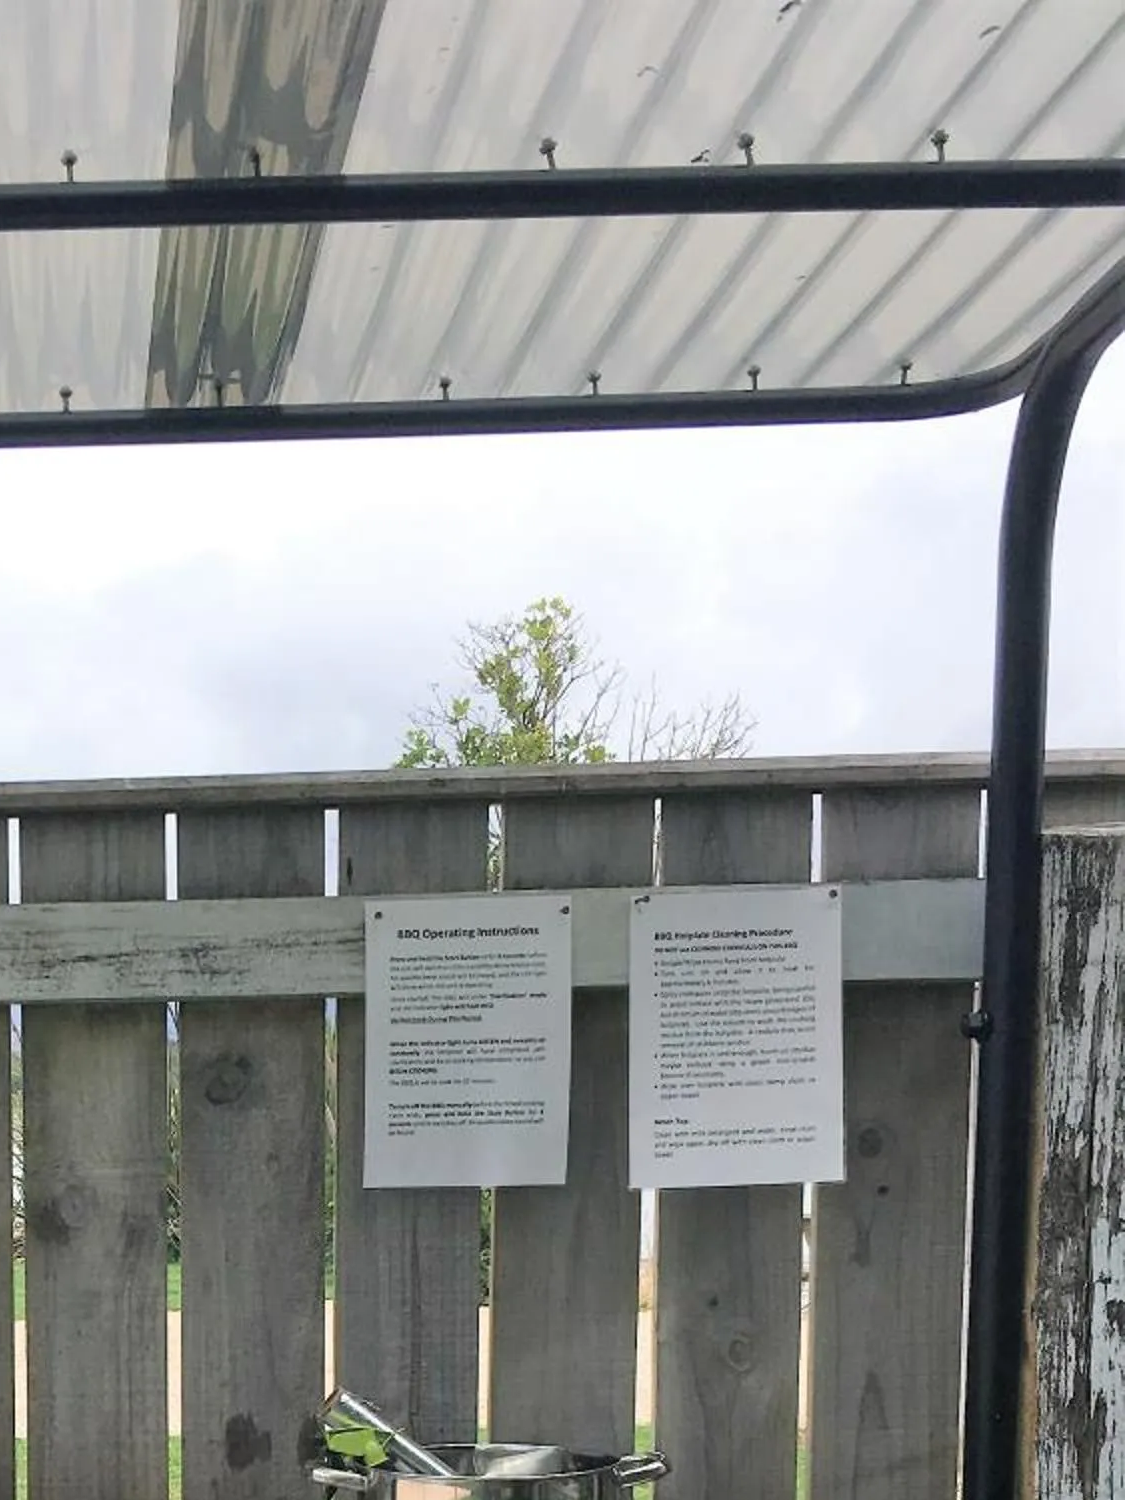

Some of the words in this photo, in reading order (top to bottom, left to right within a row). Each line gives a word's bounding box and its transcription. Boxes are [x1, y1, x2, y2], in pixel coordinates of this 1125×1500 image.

[396, 928, 420, 940] BBQ
[422, 927, 475, 940] Operating
[476, 925, 540, 937] Instructions
